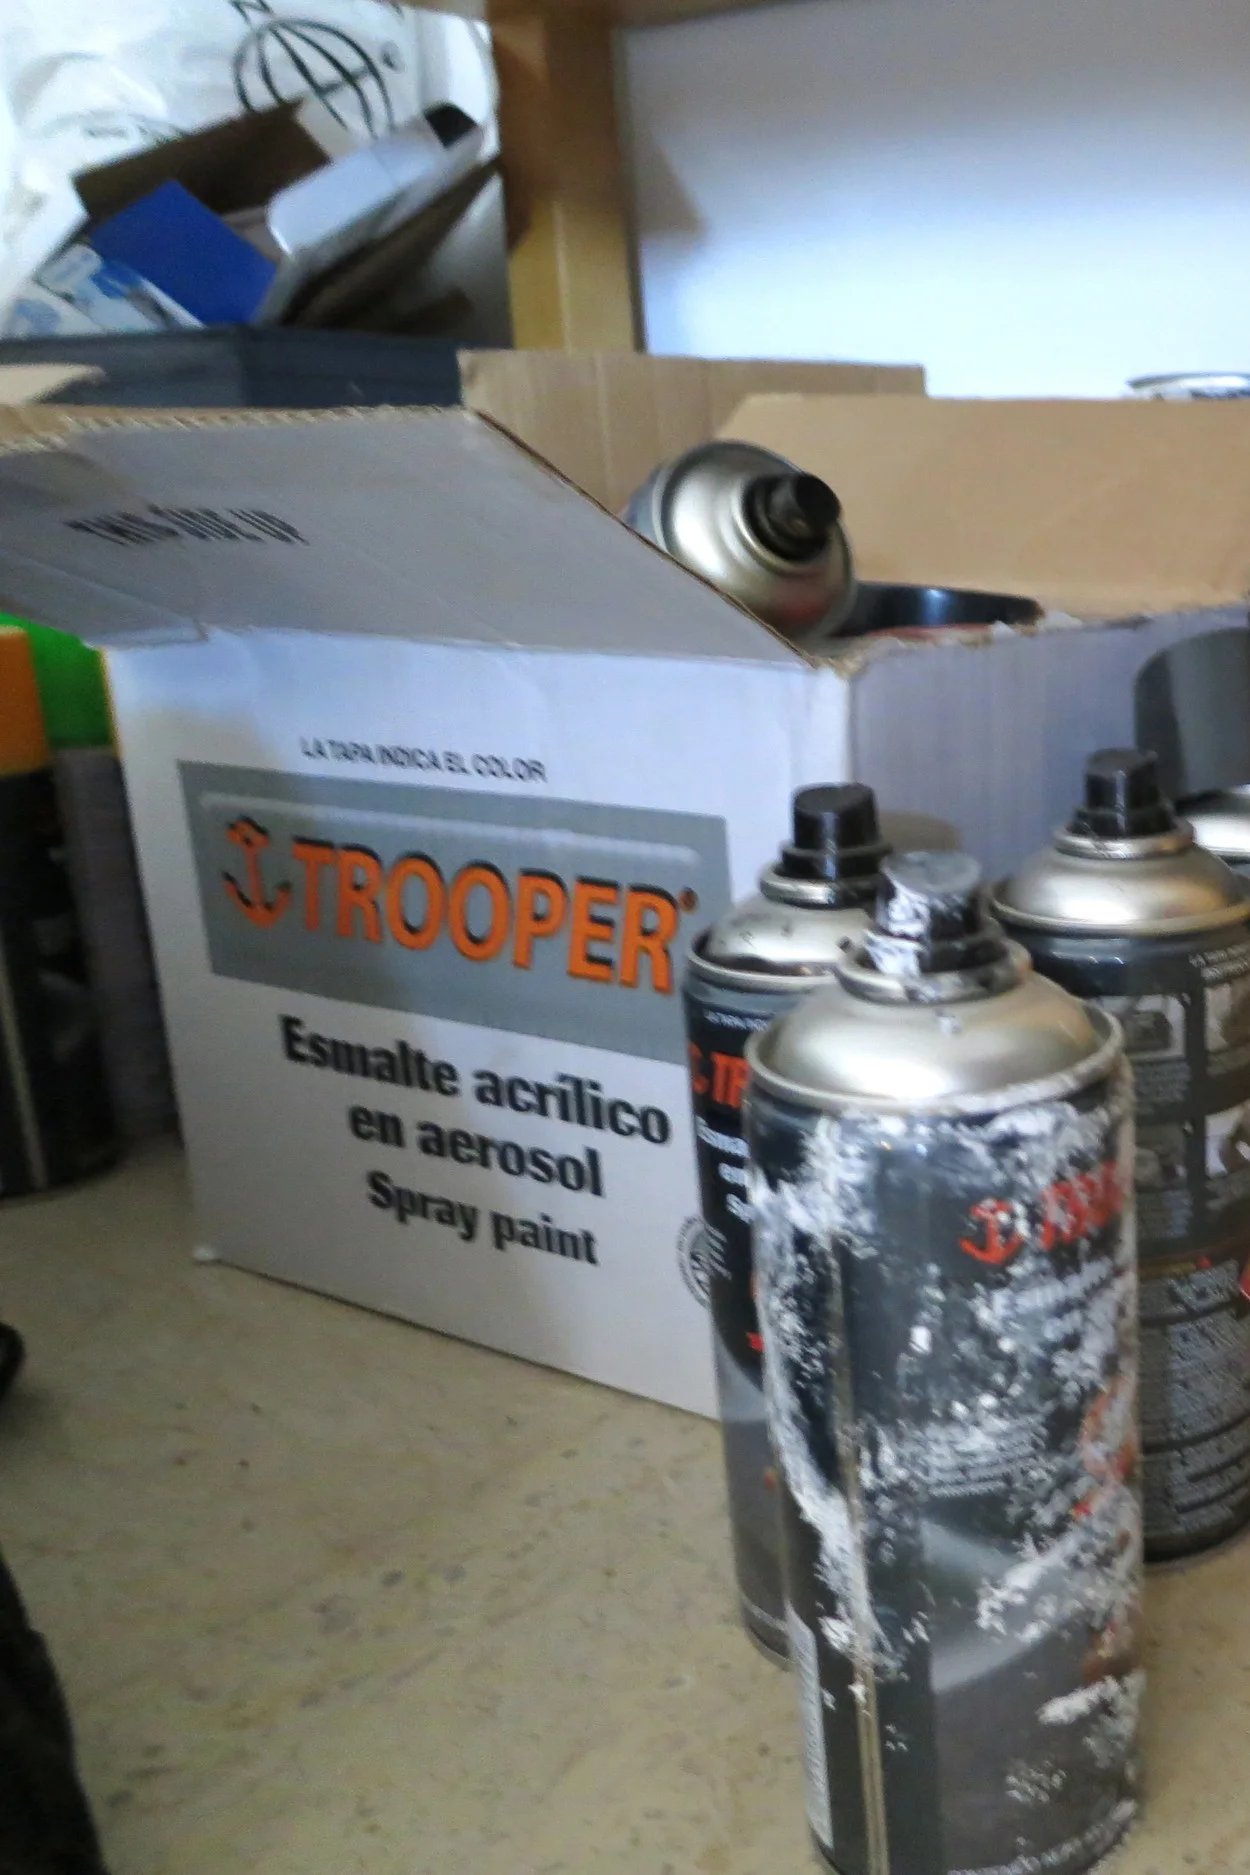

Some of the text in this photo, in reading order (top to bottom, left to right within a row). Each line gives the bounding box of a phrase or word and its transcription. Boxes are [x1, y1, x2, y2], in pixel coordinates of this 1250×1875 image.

[299, 737, 548, 784] LA TAPA INDICA EL COLOR
[291, 834, 681, 995] TROOPER
[278, 1013, 671, 1145] Esmalte acrílico
[347, 1102, 604, 1198] en aerosol
[366, 1169, 479, 1242] Spray
[490, 1210, 599, 1267] paint
